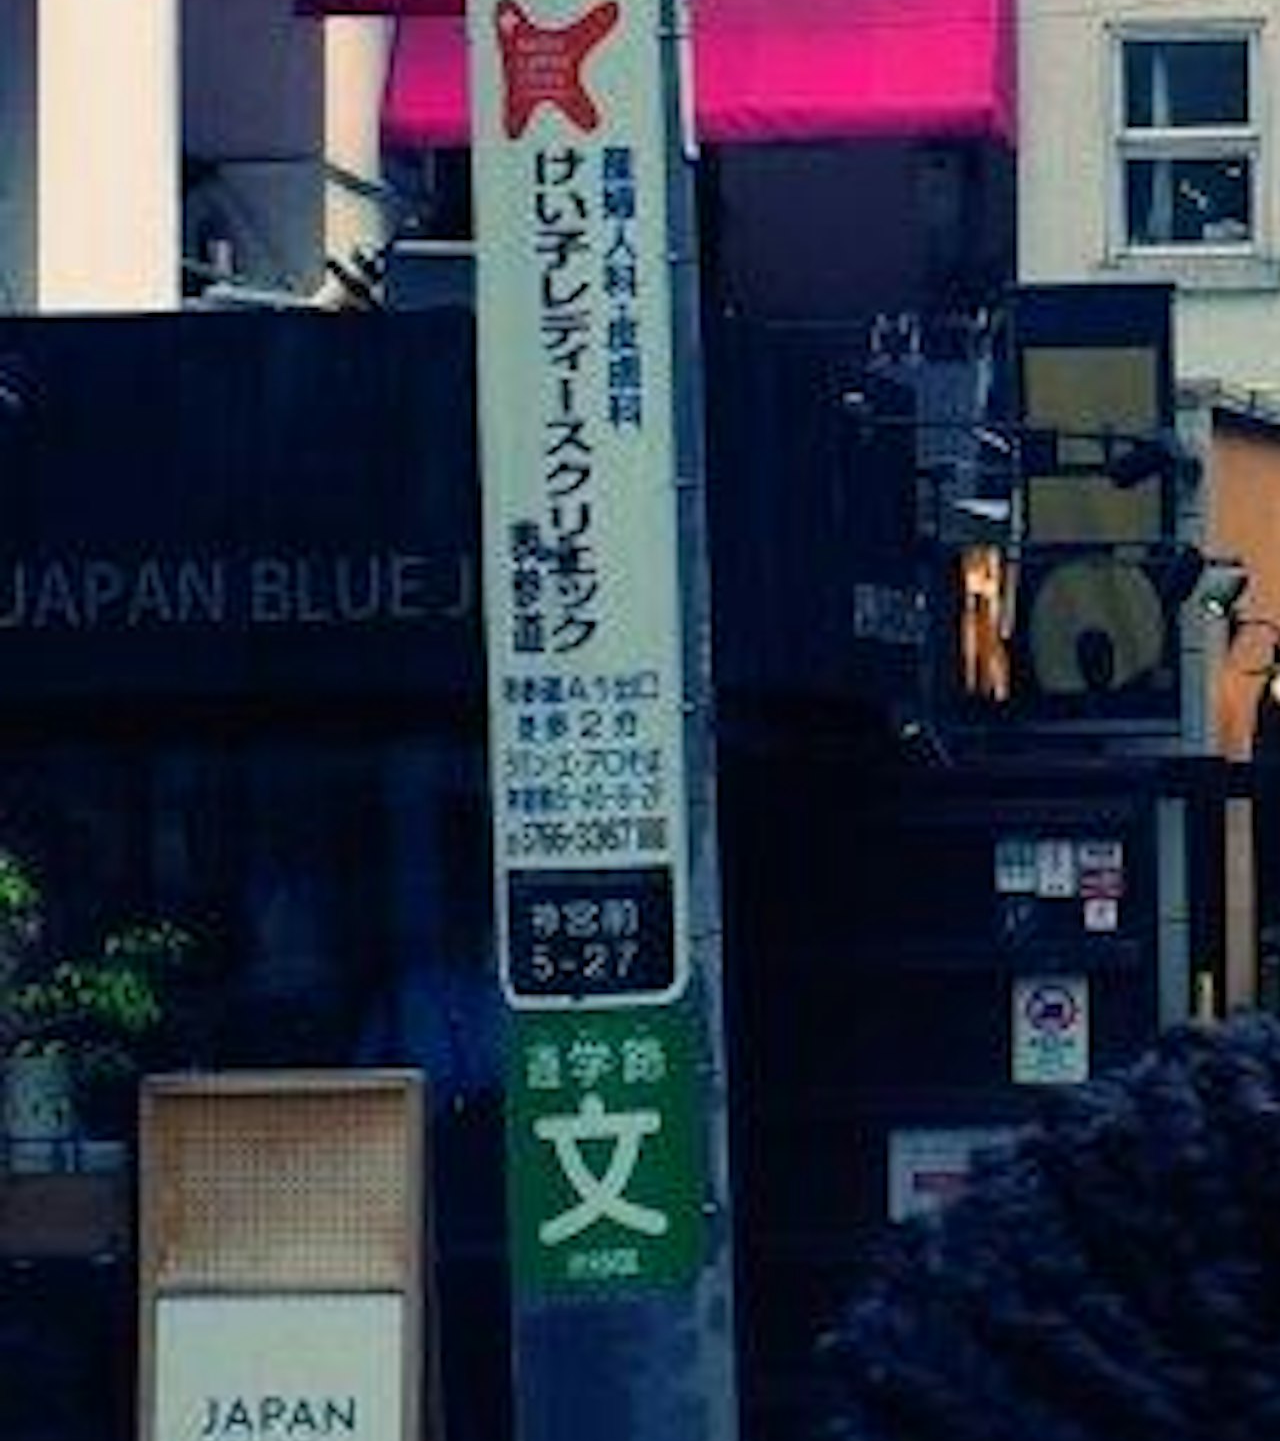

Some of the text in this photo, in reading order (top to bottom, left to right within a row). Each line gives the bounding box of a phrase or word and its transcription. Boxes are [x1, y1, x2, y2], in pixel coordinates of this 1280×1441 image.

[0, 557, 226, 629] JAPAN
[250, 555, 432, 623] BLUE
[531, 940, 640, 982] 5-27
[532, 1092, 669, 1248] 文
[203, 1396, 357, 1437] JAPAN
